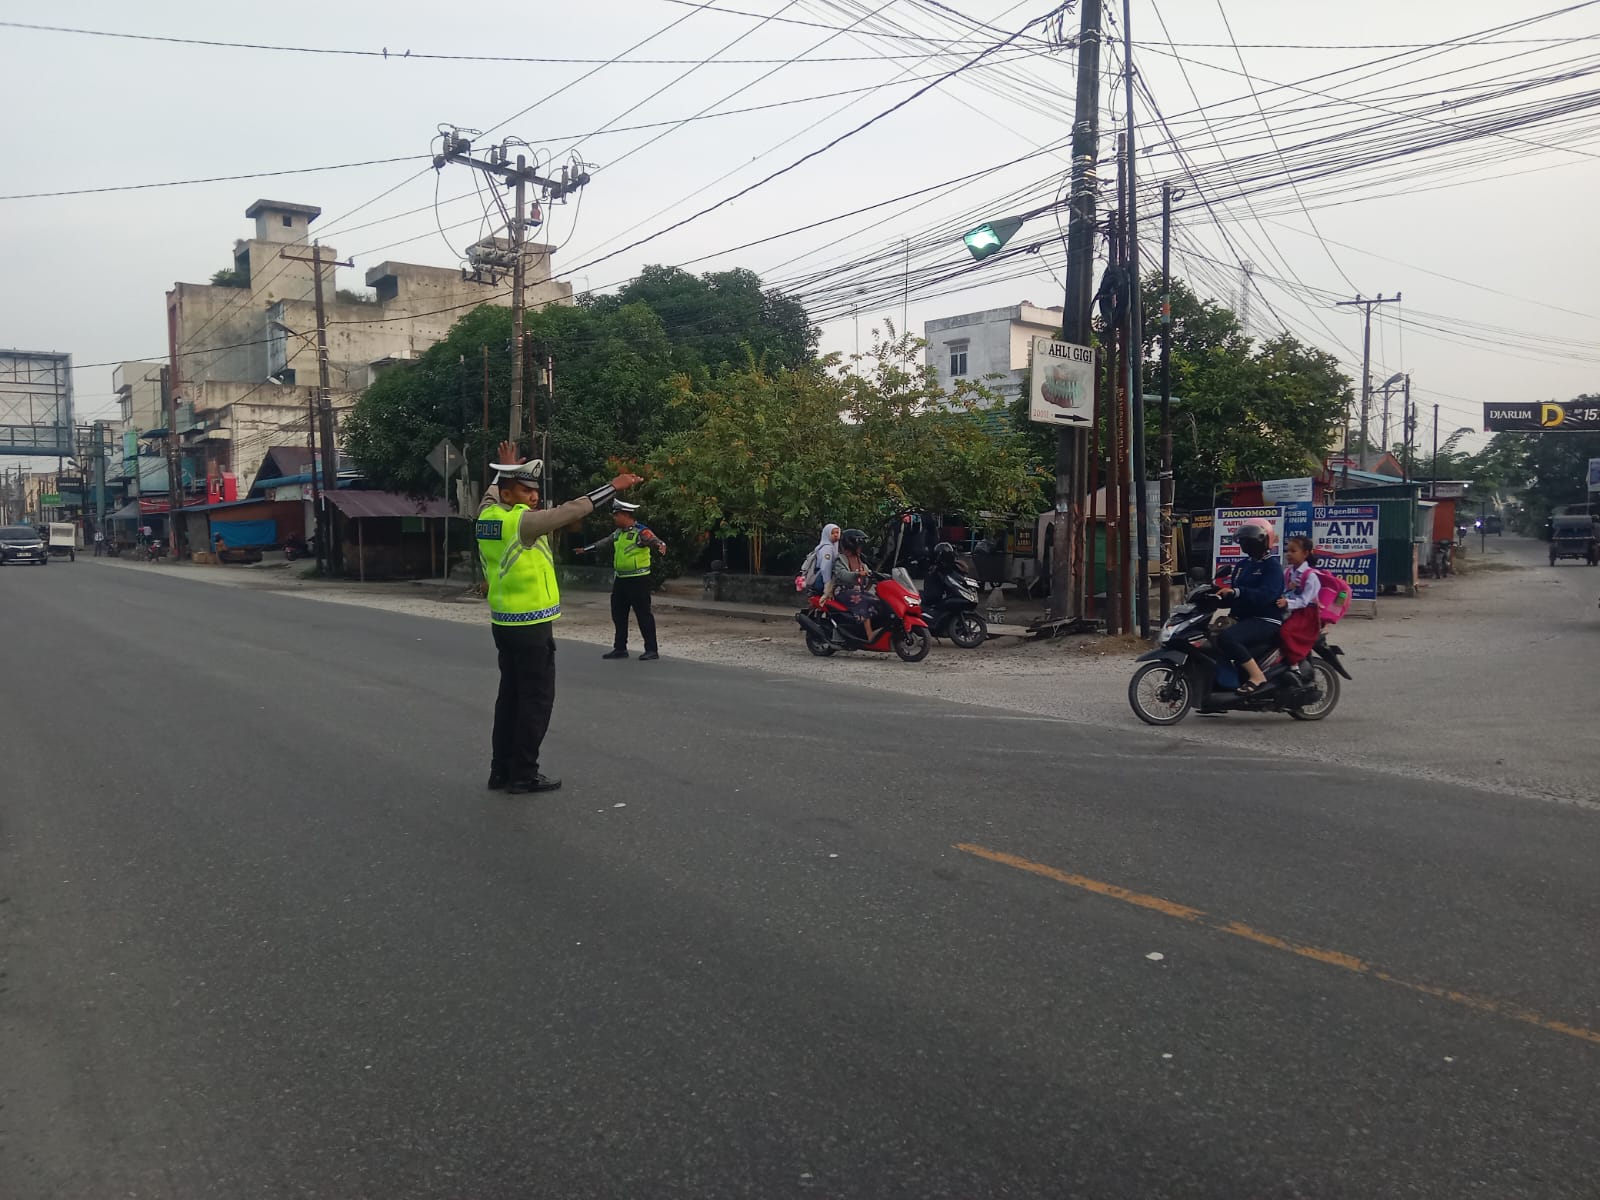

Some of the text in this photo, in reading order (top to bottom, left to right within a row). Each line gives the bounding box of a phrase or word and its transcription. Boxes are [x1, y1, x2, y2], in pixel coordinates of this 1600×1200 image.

[1048, 344, 1092, 362] AHLI GIGI
[1489, 410, 1532, 419] DJARUM
[1222, 509, 1278, 518] PROOOMOOO
[1327, 521, 1374, 536] ATM
[1319, 537, 1368, 545] BERSAMA
[1316, 558, 1356, 569] DISINI
